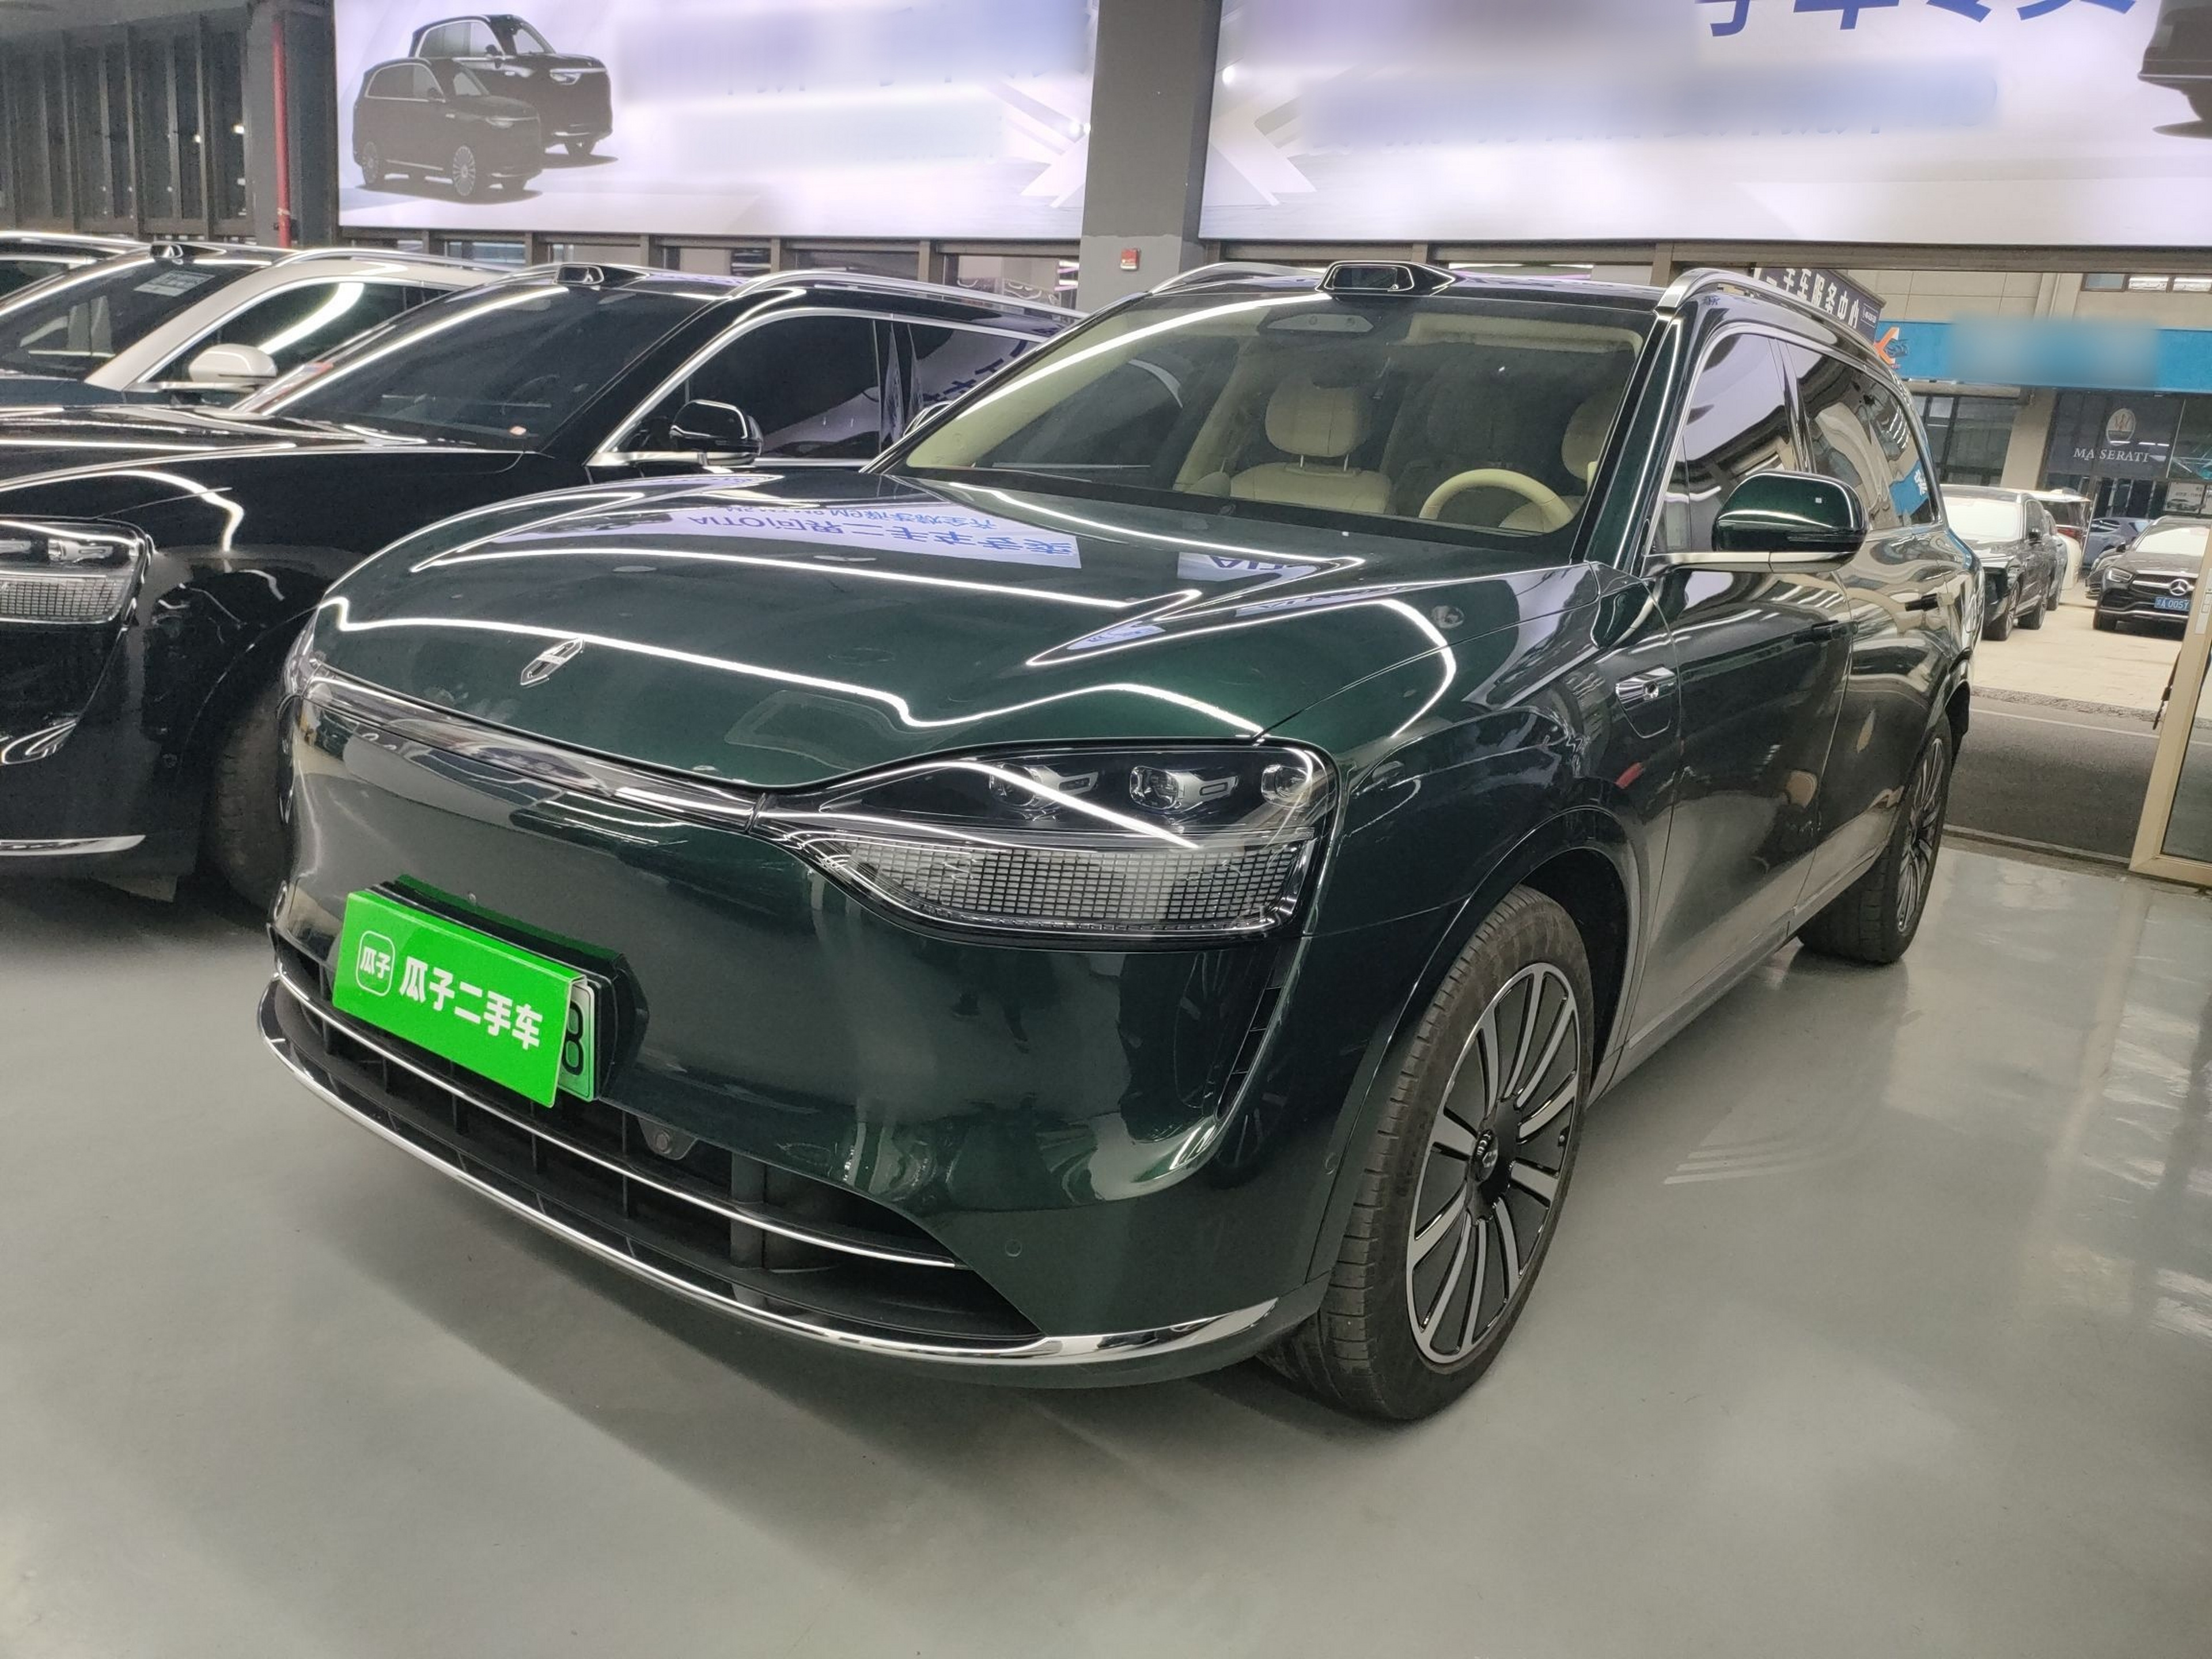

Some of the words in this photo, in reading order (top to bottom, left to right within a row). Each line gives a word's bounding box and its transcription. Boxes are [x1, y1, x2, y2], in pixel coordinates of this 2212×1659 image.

[359, 946, 391, 979] 瓜子
[399, 956, 544, 1051] 瓜子二手车
